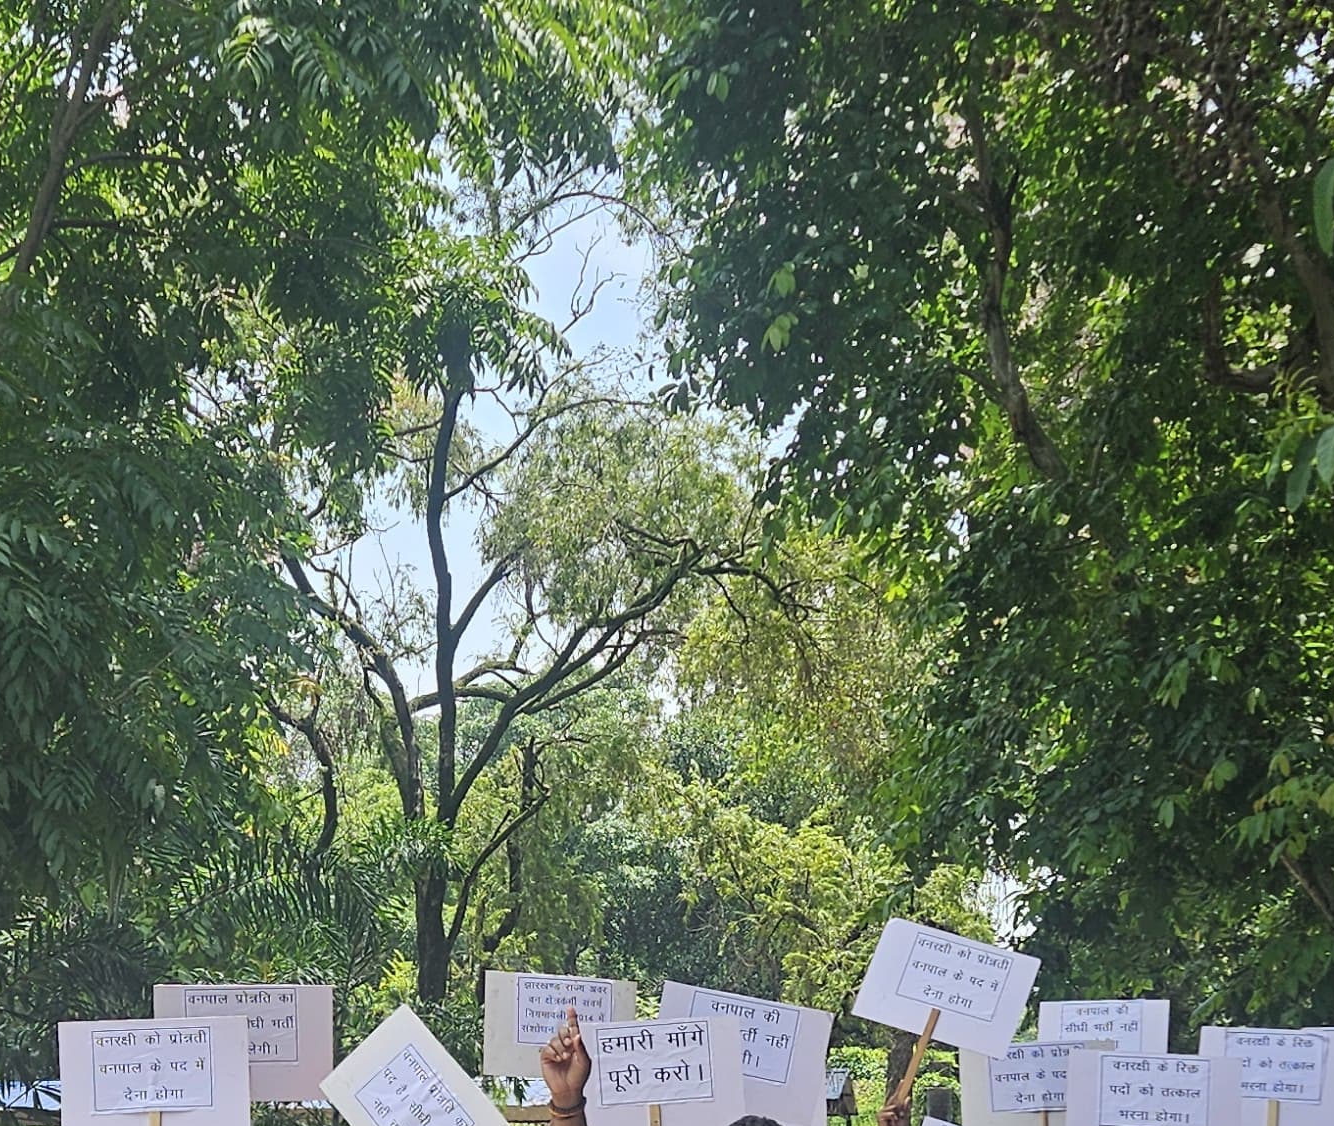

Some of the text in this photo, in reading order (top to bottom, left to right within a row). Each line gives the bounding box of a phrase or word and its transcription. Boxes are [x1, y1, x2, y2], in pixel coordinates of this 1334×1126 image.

[918, 938, 952, 955] वनरक्षी
[957, 948, 971, 960] को
[912, 959, 947, 976] वनपाल
[953, 969, 963, 980] के
[970, 976, 985, 988] पद
[187, 993, 228, 1005] वनपाल
[279, 993, 294, 1003] का
[923, 985, 972, 1008] देना होगा
[711, 1000, 780, 1024] वनपाल की
[272, 1016, 294, 1029] भर्ती
[95, 1032, 136, 1047] वनरक्षी
[145, 1032, 160, 1044] को
[600, 1029, 654, 1053] हमारी
[766, 1034, 792, 1049] नहीं
[100, 1057, 206, 1074] वनपाल के पद में
[403, 1049, 429, 1083] वनपाल
[1113, 1060, 1200, 1073] वनरक्षी के रिक्त
[608, 1064, 641, 1093] पूरी
[124, 1087, 184, 1101] देना होगा
[384, 1068, 397, 1084] पद
[409, 1101, 431, 1126] सीधी
[1110, 1082, 1201, 1098] पदों को तत्काल
[373, 1099, 391, 1118] नहीं
[1119, 1109, 1149, 1121] भरना
